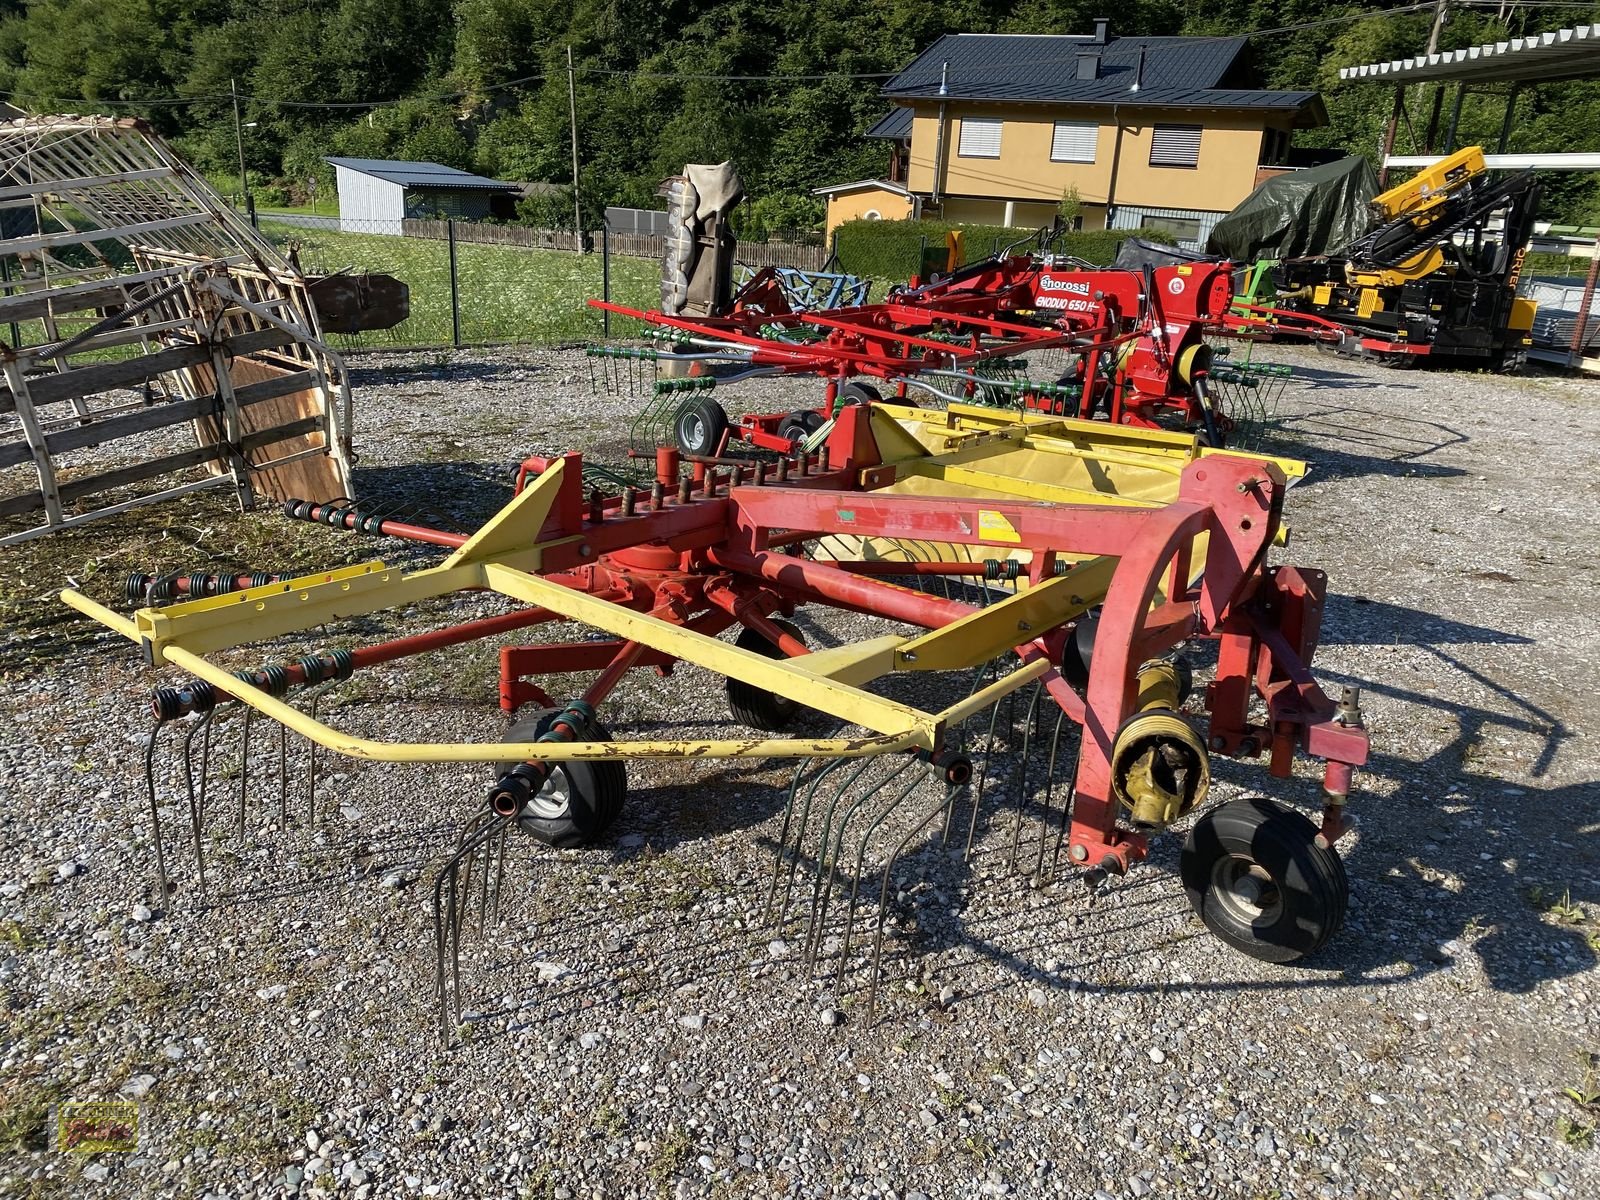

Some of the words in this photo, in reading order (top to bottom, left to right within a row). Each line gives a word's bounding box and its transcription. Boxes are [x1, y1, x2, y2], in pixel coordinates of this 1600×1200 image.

[1040, 275, 1090, 293] enorossi
[1035, 296, 1068, 309] ENODUO
[1068, 299, 1087, 311] 650
